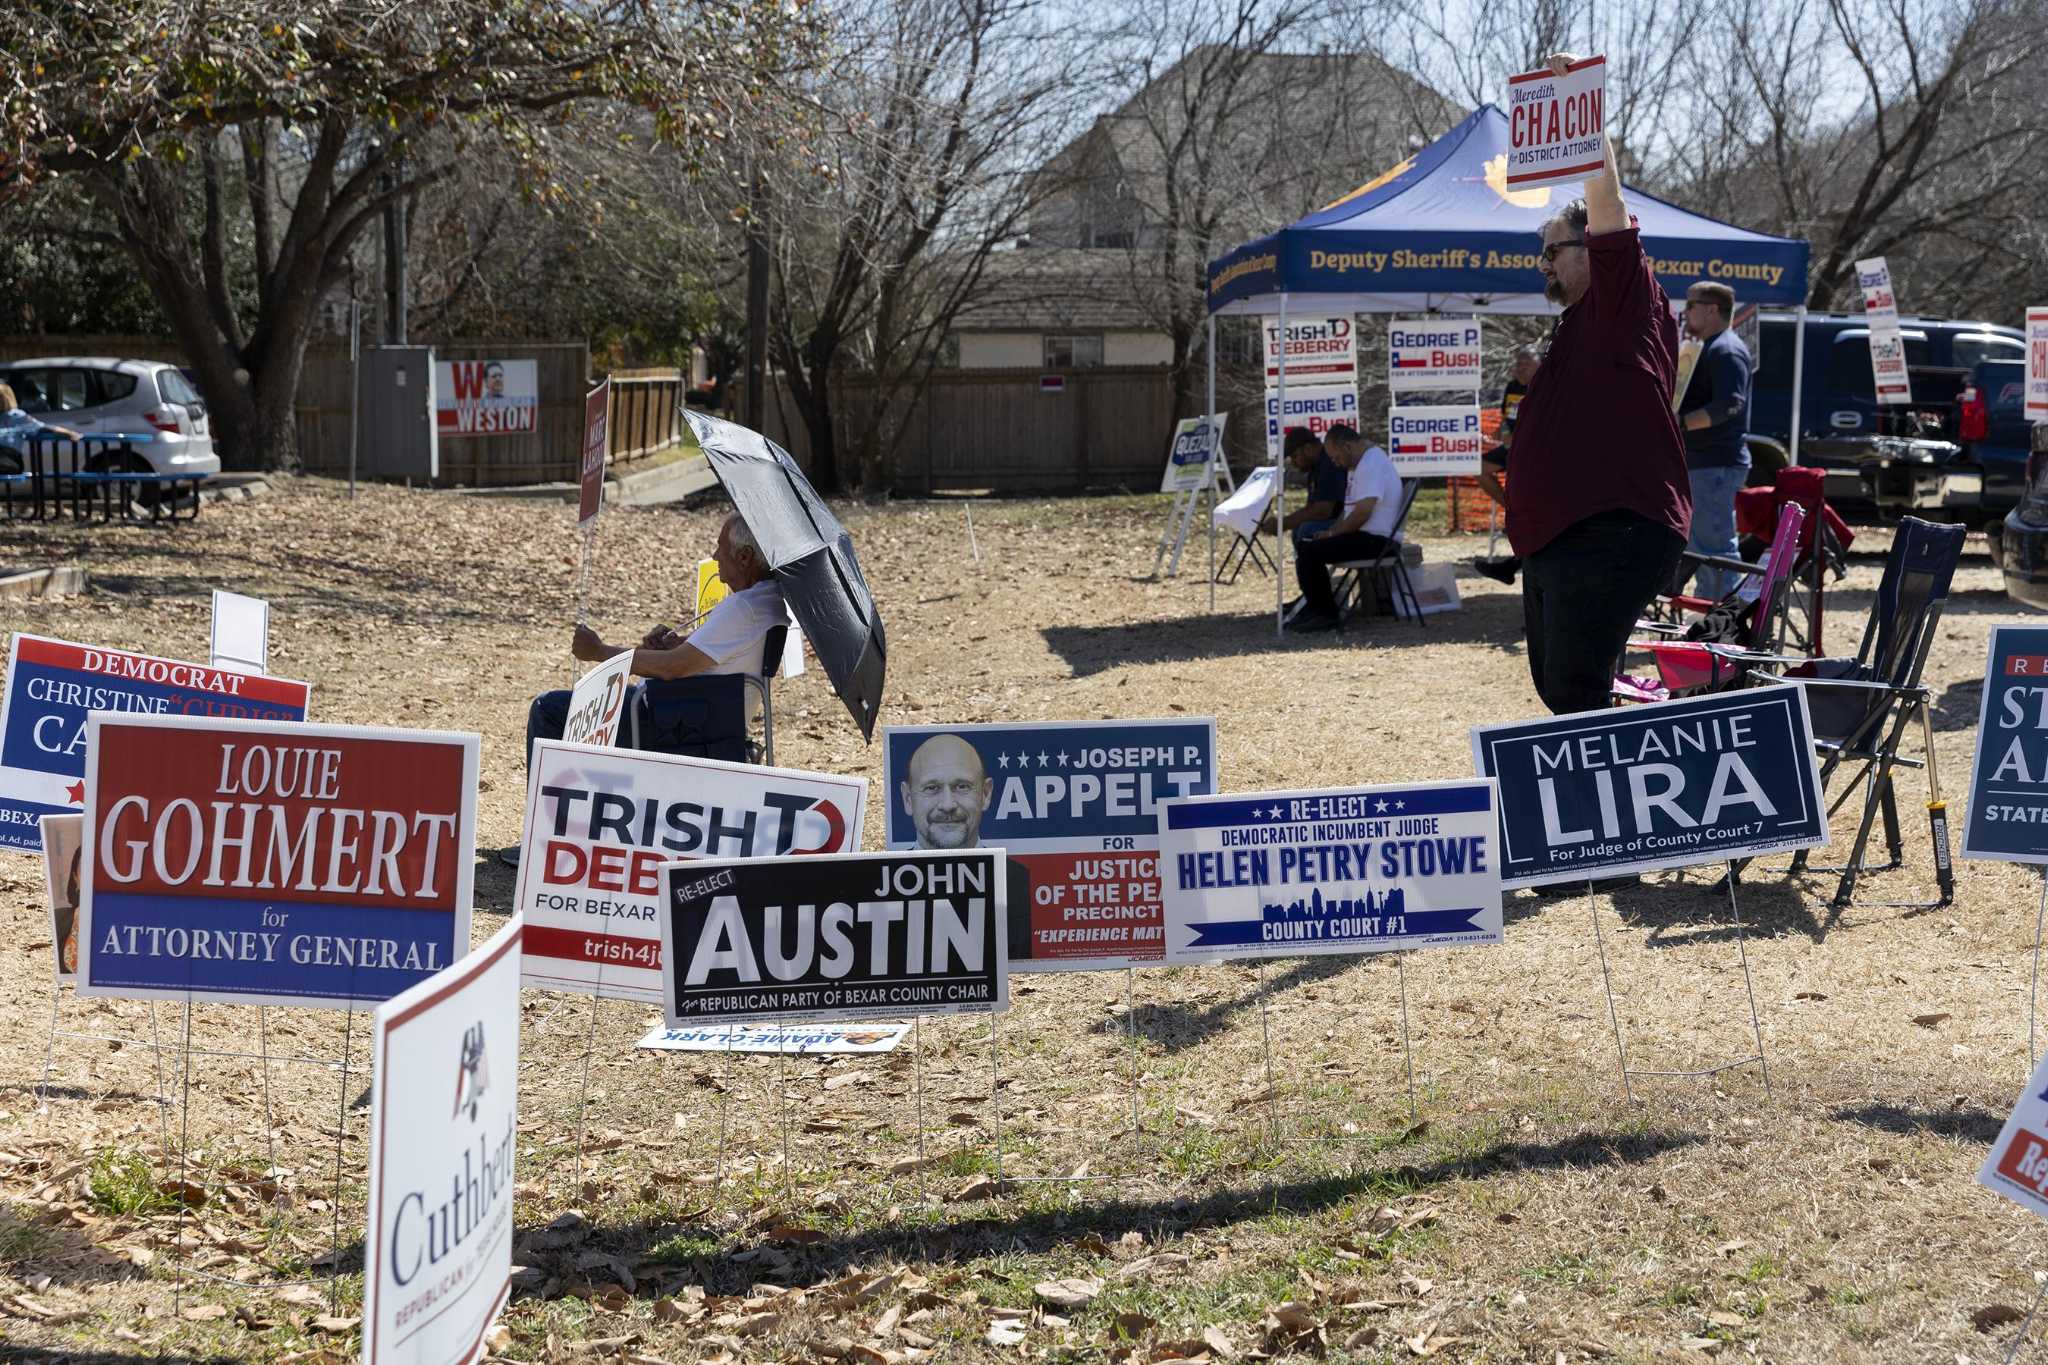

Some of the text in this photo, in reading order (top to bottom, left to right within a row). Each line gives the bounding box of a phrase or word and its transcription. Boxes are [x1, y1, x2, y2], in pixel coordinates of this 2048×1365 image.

[1512, 84, 1555, 104] Meredith
[1511, 88, 1602, 148] CHACON
[1519, 146, 1561, 164] DISTRICT
[1562, 138, 1601, 158] ATTORNEY
[1310, 250, 1388, 272] Deputy
[1392, 249, 1480, 268] Sheriff's
[1707, 259, 1785, 286] County
[1266, 325, 1327, 341] TRISH
[1391, 329, 1479, 348] GEORGE P.
[1431, 351, 1479, 367] BUSH
[451, 361, 485, 399] W
[456, 406, 532, 432] WESTON
[1268, 394, 1356, 416] GEORGE P.
[1391, 415, 1479, 433] GEORGE P.
[1431, 436, 1479, 453] BUSH
[82, 651, 245, 695] DEMOCRAT
[27, 678, 170, 713] CHRISTINE
[567, 693, 604, 742] TRISH
[1073, 745, 1203, 769] JOSEPH P.
[1532, 714, 1757, 776] MELANIE
[215, 743, 343, 800] LOUIE
[995, 771, 1201, 820] APPELT
[1290, 796, 1368, 821] RE-ELECT
[1537, 752, 1779, 847] LIRA
[541, 785, 757, 856] TRISH
[1221, 817, 1439, 847] DEMOCRATIC INCUMBENT JUDGE
[23, 839, 42, 848] paid
[100, 795, 458, 899] GOHMERT
[1102, 836, 1135, 850] FOR
[1550, 821, 1764, 862] For Judge of County Court 7
[1936, 824, 1947, 864] ROCKER
[1177, 848, 1271, 890] HELEN
[1279, 841, 1373, 884] PETRY
[1379, 835, 1488, 879] STOWE
[676, 868, 735, 904] RE-ELECT
[874, 862, 986, 897] JOHN
[1035, 885, 1065, 905] OF
[1073, 884, 1121, 903] THE
[261, 906, 289, 928] for
[535, 893, 657, 922] FOR BEXAR
[1063, 905, 1160, 920] PRECINCT
[684, 895, 986, 986] AUSTIN
[1262, 915, 1408, 942] COUNTY COURT #1
[101, 925, 444, 972] ATTORNEY GENERAL
[681, 984, 989, 1013] For REPUBLICAN PARTY OF BEXAR COUNTY CHAIR
[660, 1032, 842, 1044] ADAME-CLARK
[391, 1112, 513, 1287] Cuthbert
